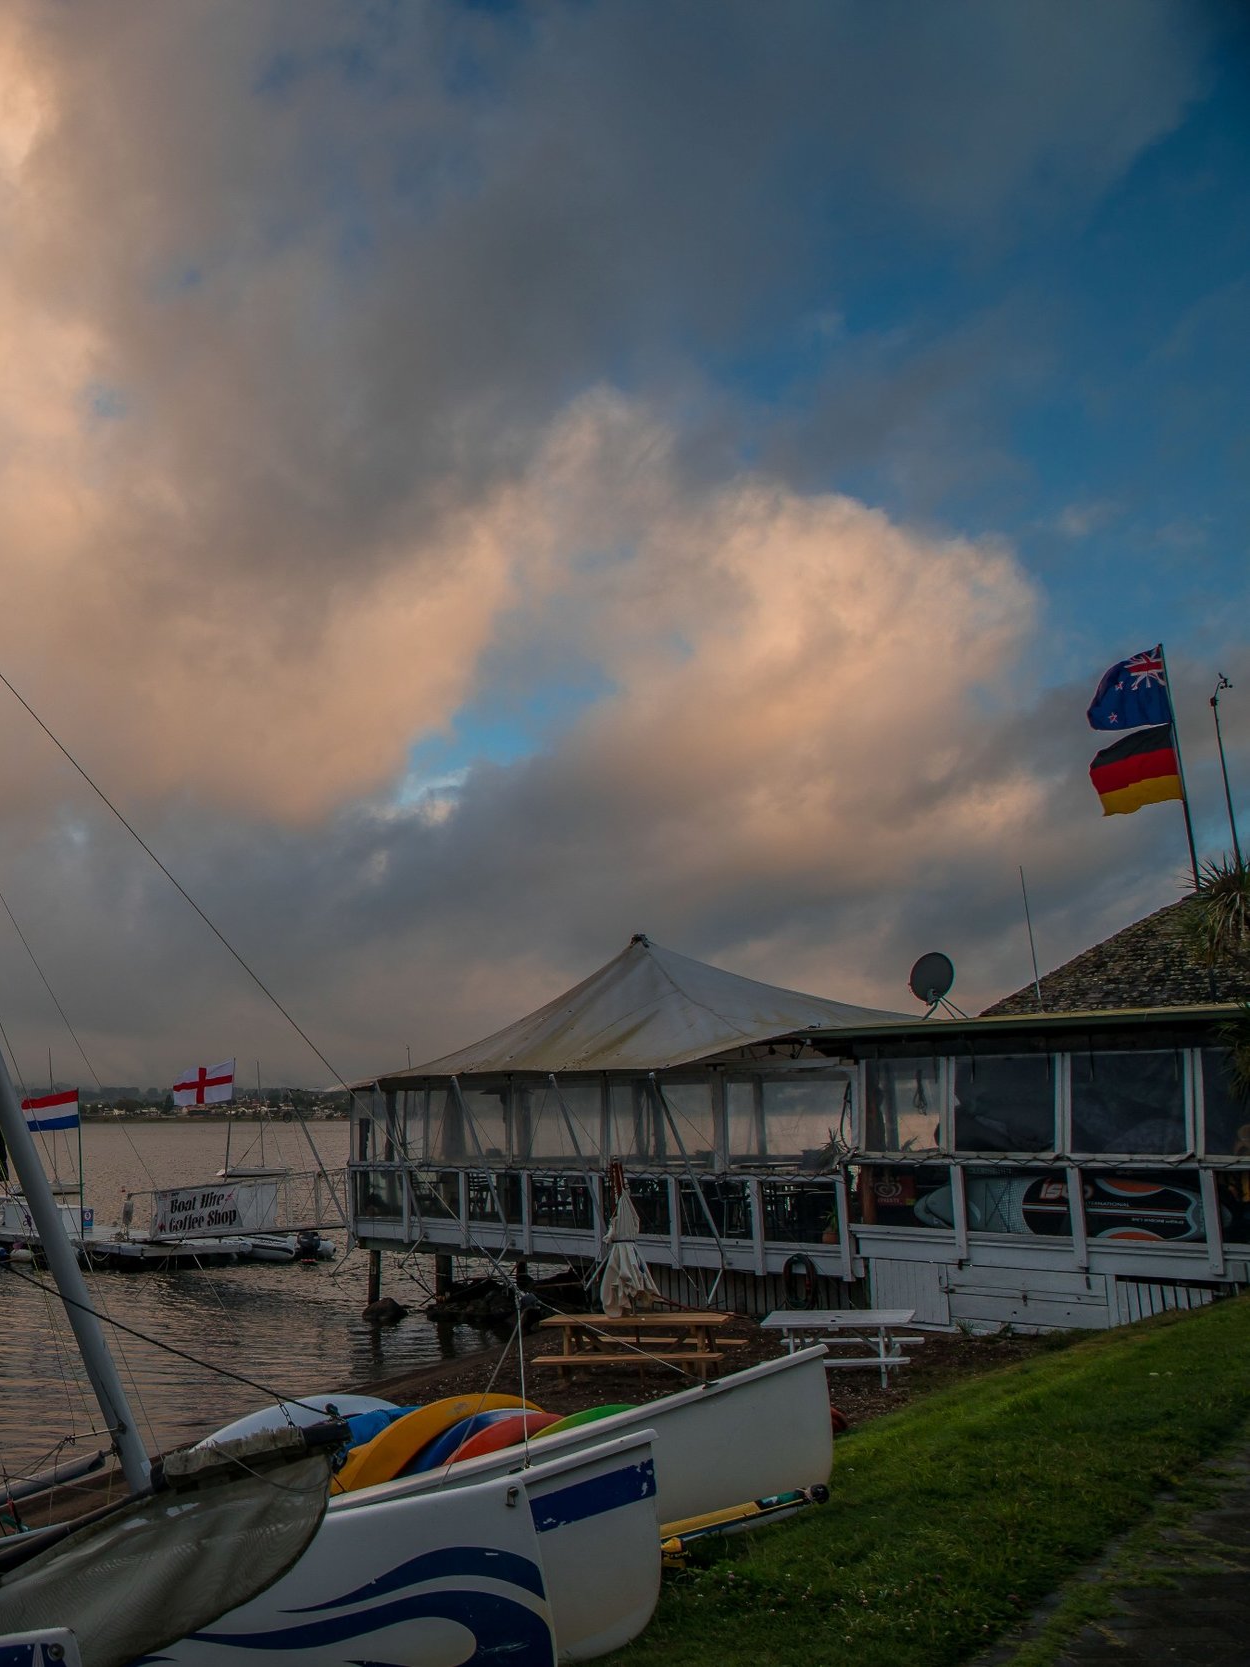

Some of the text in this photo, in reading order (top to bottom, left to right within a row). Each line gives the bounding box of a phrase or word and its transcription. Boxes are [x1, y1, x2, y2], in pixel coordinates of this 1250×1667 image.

[170, 1192, 224, 1213] Boat Hire
[169, 1209, 236, 1232] Coffee Shop
